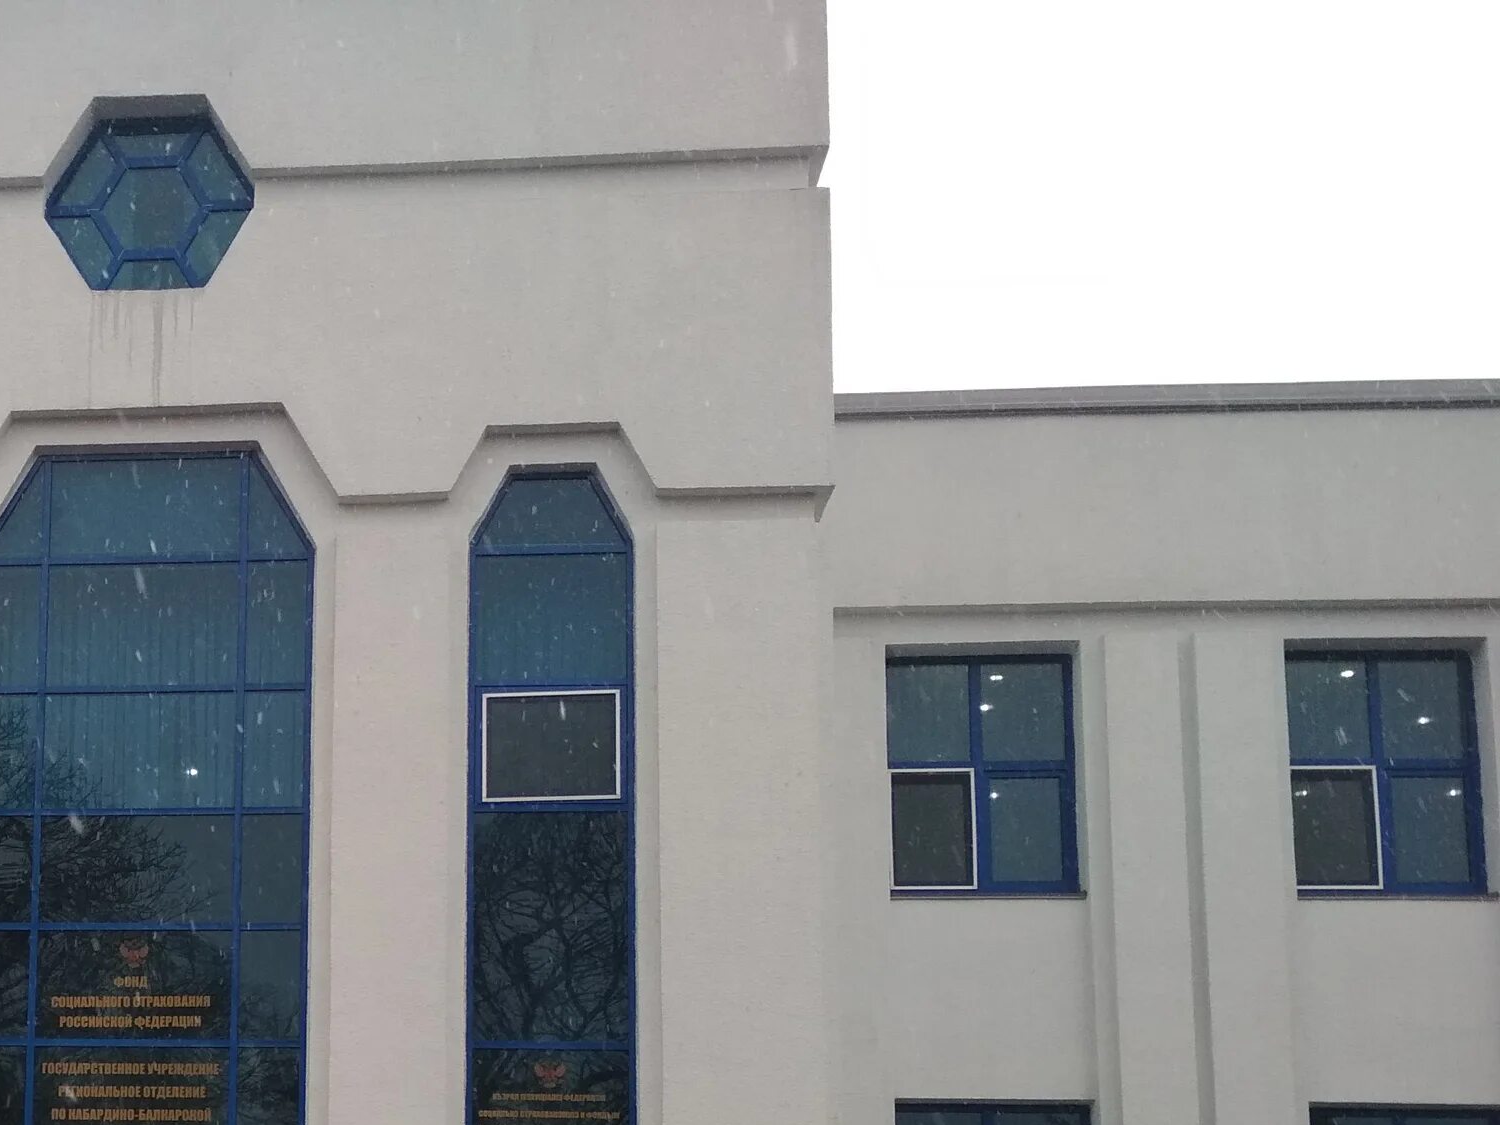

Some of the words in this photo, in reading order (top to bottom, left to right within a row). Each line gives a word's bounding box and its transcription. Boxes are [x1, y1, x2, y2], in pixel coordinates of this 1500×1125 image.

[113, 976, 148, 989] ФОНД
[51, 995, 130, 1009] СОЦИАЛЬНОГО
[133, 995, 211, 1008] СТРАХОВАНИЯ
[59, 1015, 132, 1028] РОССИЙСКОЙ
[134, 1016, 202, 1030] ФЕДЕРАЦИИ
[41, 1062, 146, 1075] ГОСУДАРСТВЕННОЕ
[58, 1085, 141, 1098] РЕГИОНАЛЬНОЕ
[143, 1086, 207, 1100] ОТДЕЛЕНИЕ
[51, 1108, 66, 1120] ПО
